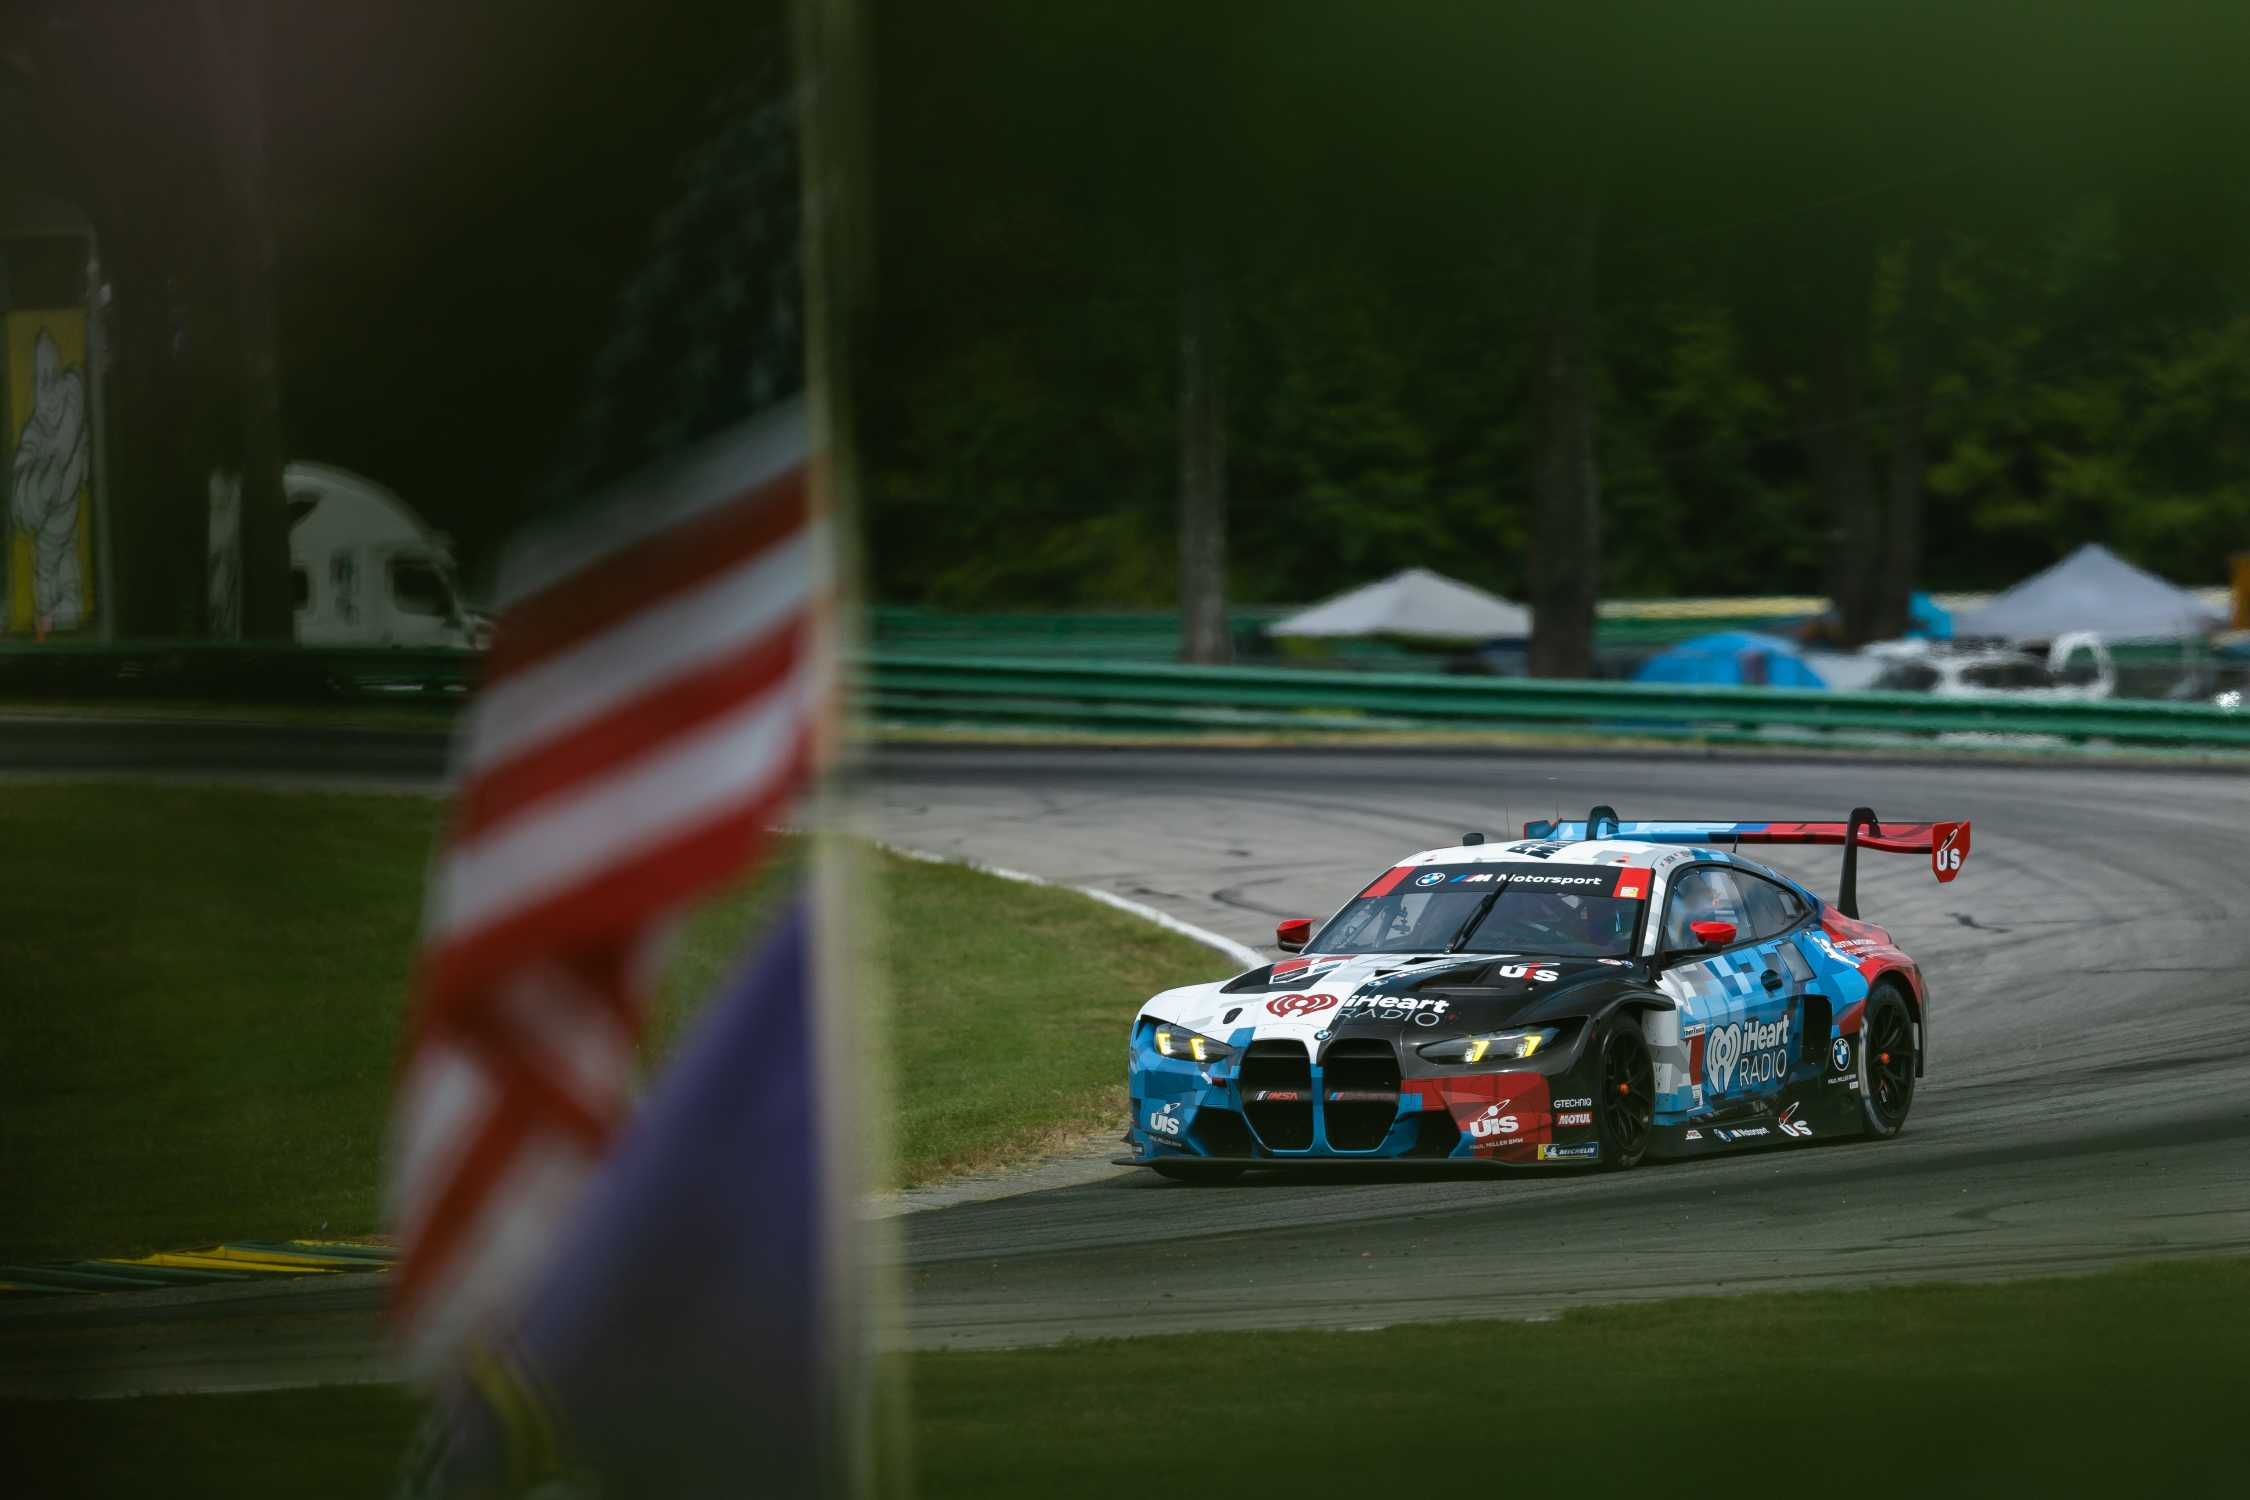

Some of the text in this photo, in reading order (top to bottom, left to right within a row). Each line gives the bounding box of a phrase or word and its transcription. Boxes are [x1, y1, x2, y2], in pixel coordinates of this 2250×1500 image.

[1496, 873, 1603, 886] Motorsport
[1343, 994, 1450, 1014] iHeart
[1335, 1007, 1440, 1027] RADIO
[1742, 1014, 1790, 1054] iHeart
[1740, 1048, 1787, 1087] RADIO
[1558, 1113, 1591, 1125] MOTUL
[1559, 1147, 1595, 1155] MICHELIN
